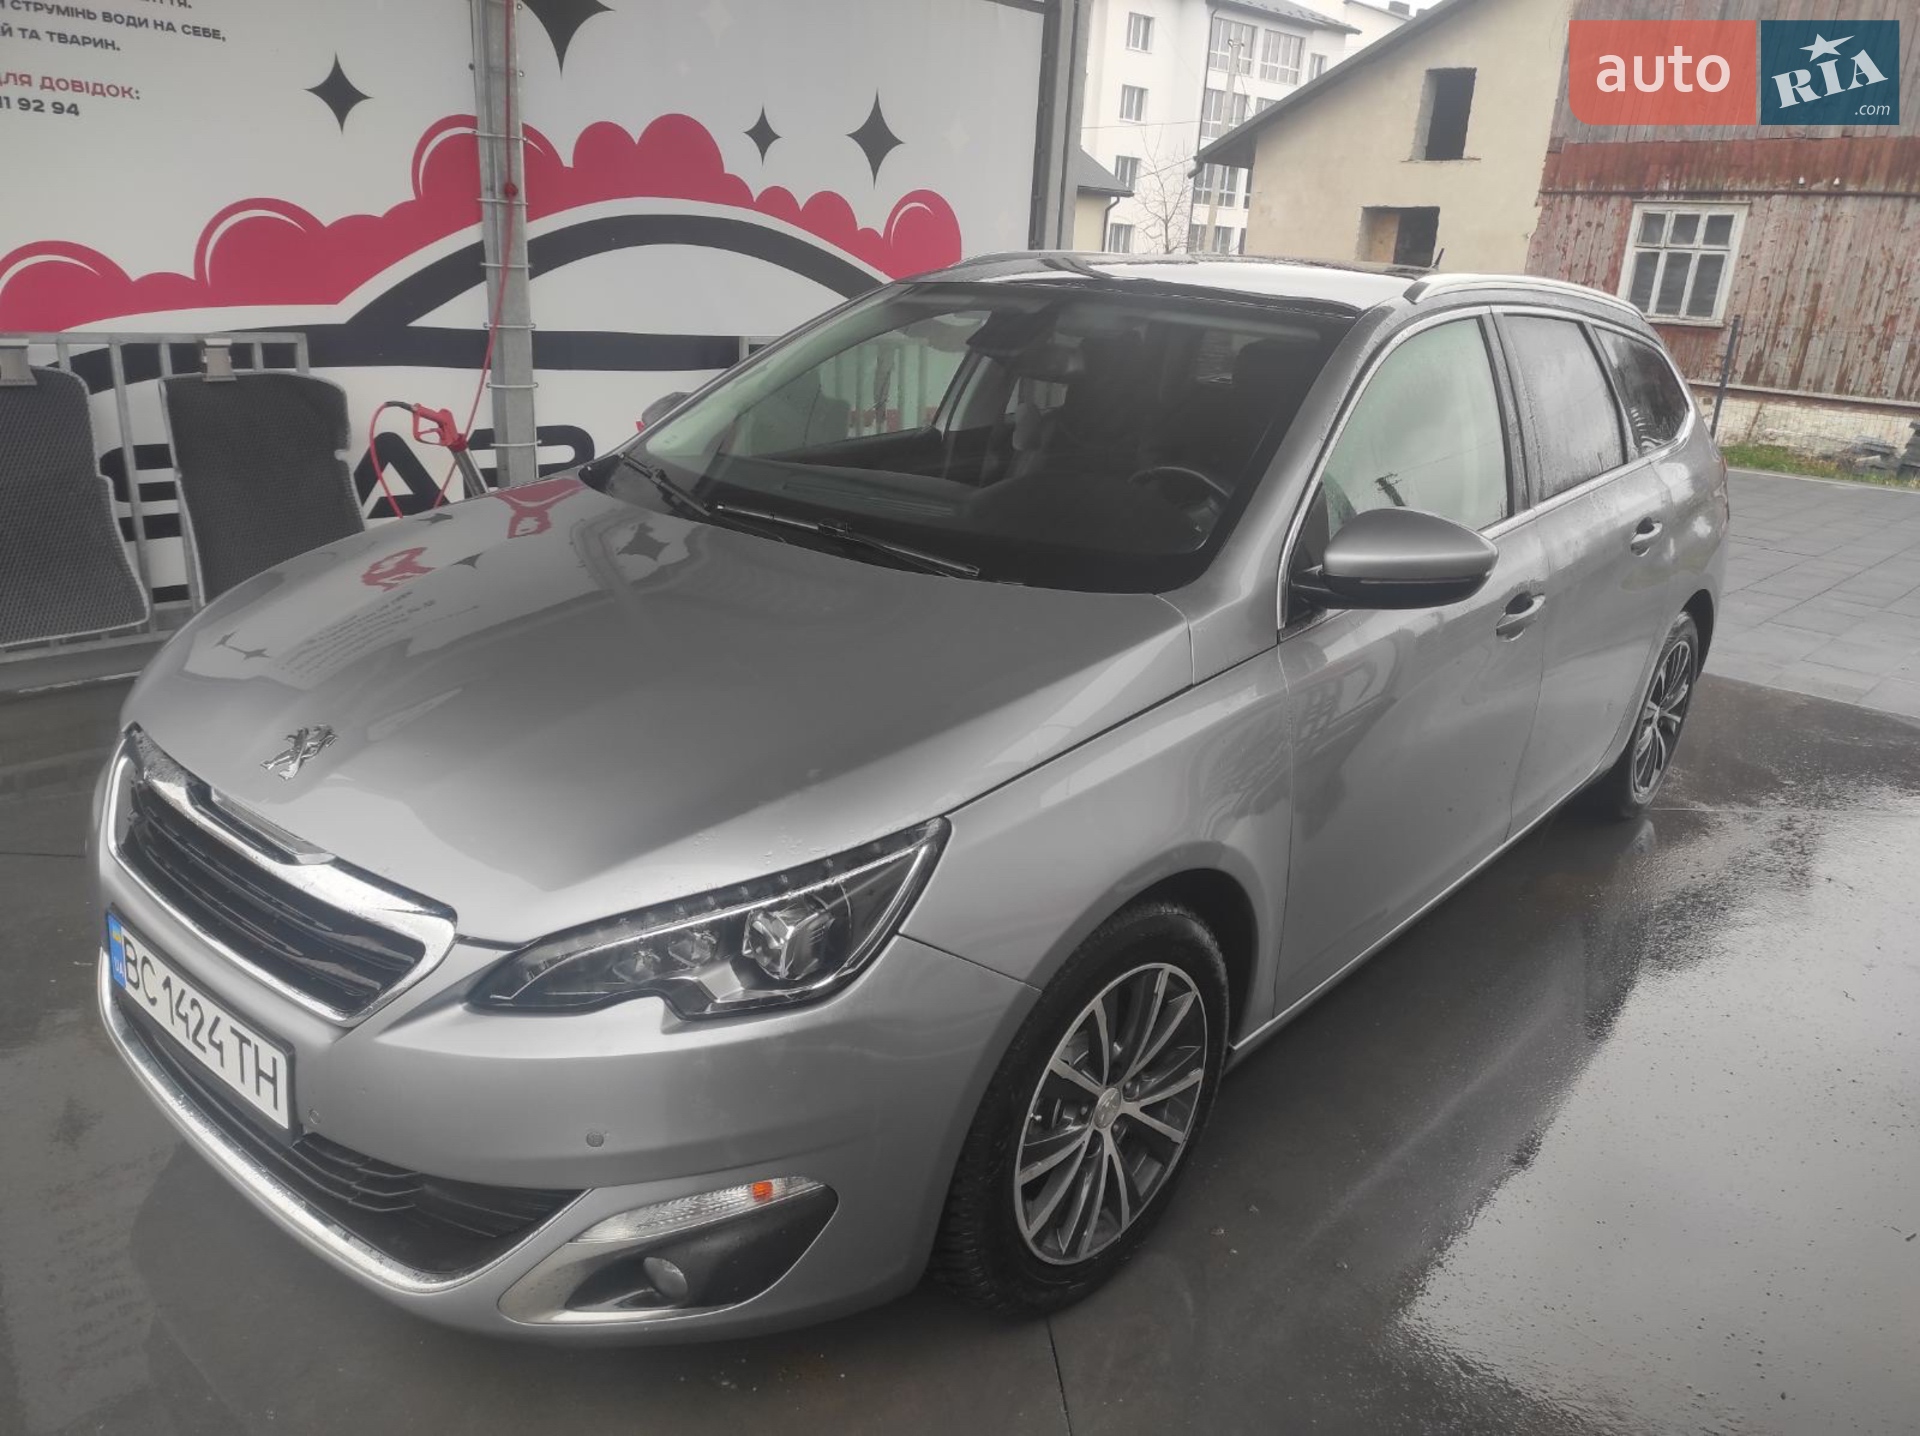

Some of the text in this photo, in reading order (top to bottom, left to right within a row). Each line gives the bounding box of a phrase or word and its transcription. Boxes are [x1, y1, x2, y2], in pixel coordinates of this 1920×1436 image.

[10, 0, 97, 20] СТРУМІНЬ
[101, 11, 149, 29] ВОДИ
[153, 19, 177, 33] НА
[181, 24, 226, 42] СЕБЕ,
[17, 27, 41, 41] ТА
[45, 30, 120, 51] ТВАРИН.
[39, 75, 140, 100] ДОВІДОК:
[17, 97, 45, 113] 92
[51, 101, 80, 116] 94
